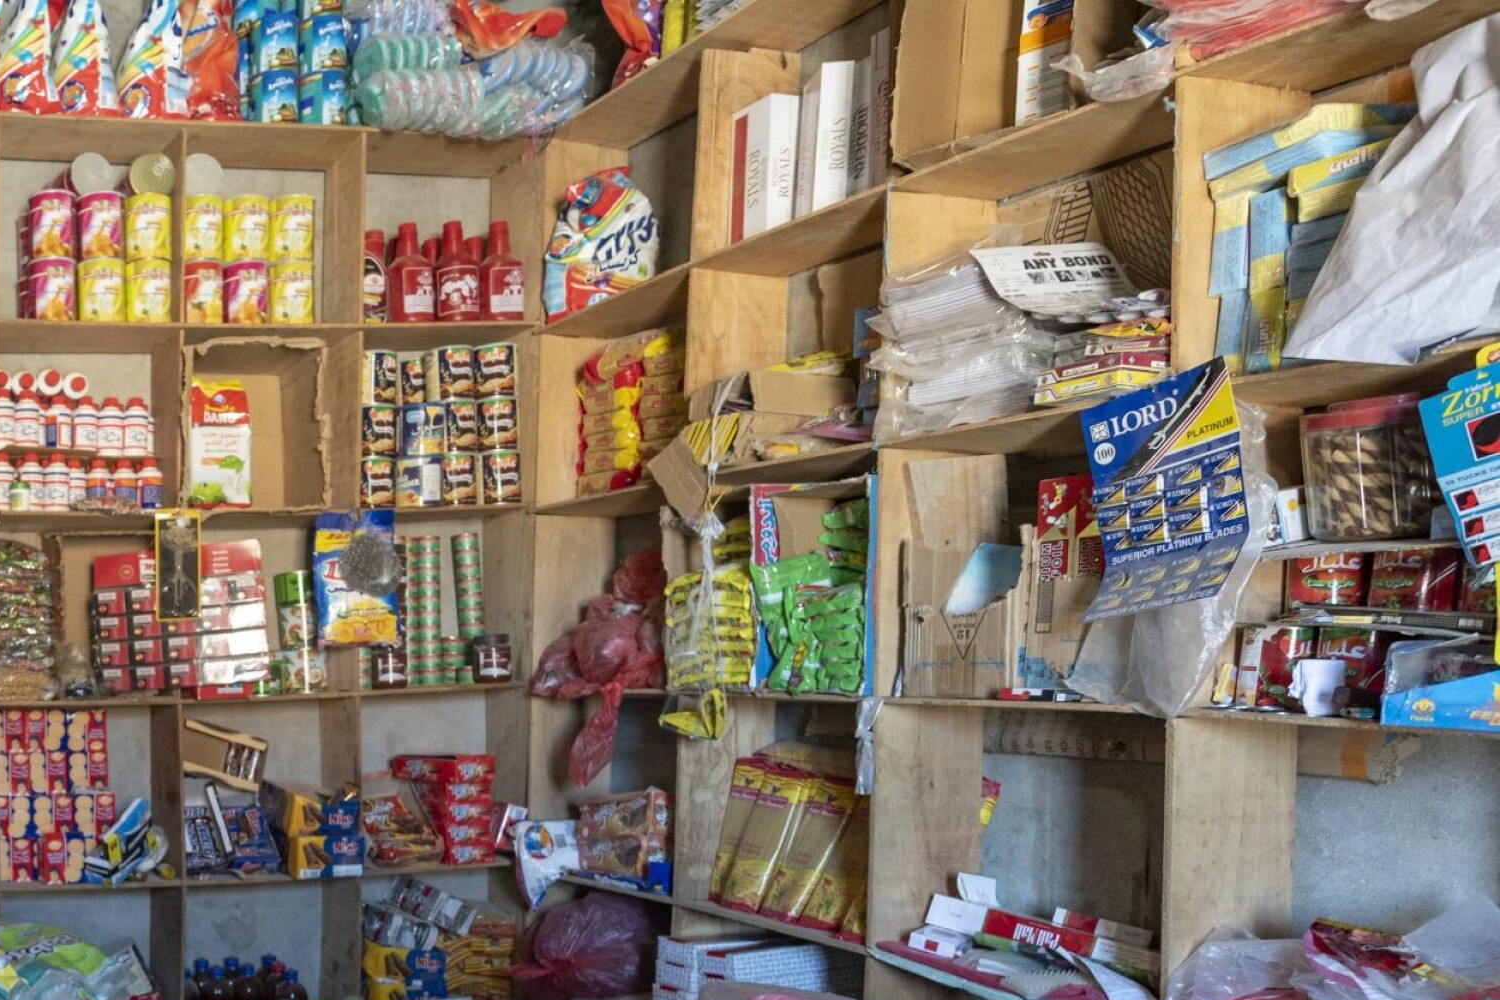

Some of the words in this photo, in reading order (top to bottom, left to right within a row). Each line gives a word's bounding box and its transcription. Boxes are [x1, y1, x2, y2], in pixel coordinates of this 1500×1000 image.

[828, 115, 848, 171] ROYALS
[747, 149, 761, 210] ROYALS
[777, 146, 792, 199] ROYALS
[1022, 258, 1057, 270] ANY
[1061, 254, 1111, 268] BOND
[1110, 396, 1178, 437] LORD
[1186, 416, 1235, 440] PLATINUM
[1442, 406, 1484, 427] SUPER
[1096, 447, 1115, 462] 100
[1051, 540, 1064, 578] FOIL
[1111, 547, 1155, 565] SUPERIOR
[1157, 535, 1202, 553] PLATINUM
[1205, 523, 1243, 541] BLADES
